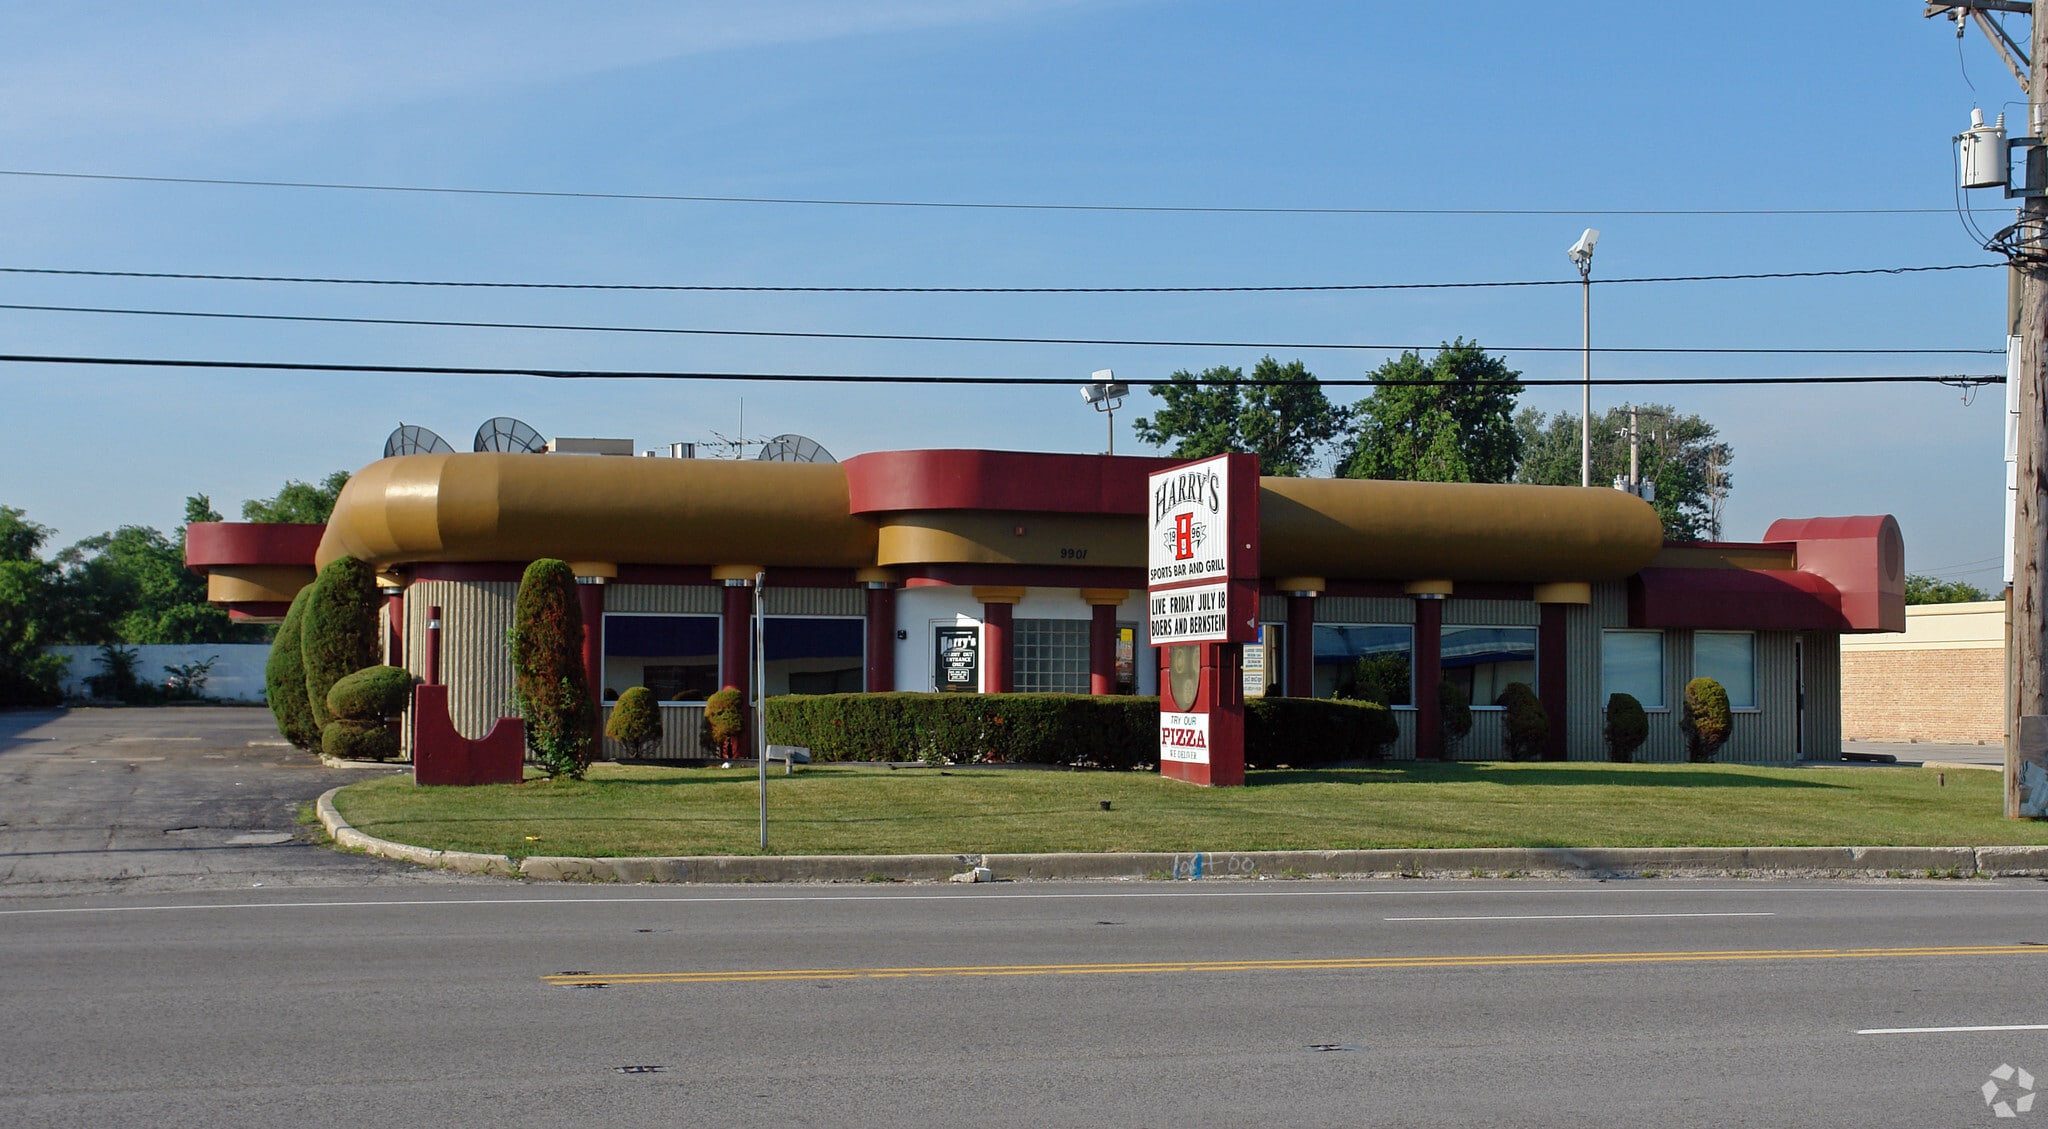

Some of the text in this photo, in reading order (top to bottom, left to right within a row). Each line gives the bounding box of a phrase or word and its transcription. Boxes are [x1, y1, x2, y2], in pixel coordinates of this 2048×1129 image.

[1155, 467, 1219, 530] HARRY'S
[1169, 512, 1201, 560] 19 H 96
[1060, 548, 1088, 560] 9901
[1150, 558, 1226, 581] SPORTS BAR AND GRILL
[1152, 591, 1226, 615] LIVE FRIDAY JULY 18
[1152, 614, 1226, 636] BOERS AND BERNSTEIN
[1171, 715, 1197, 726] TRY OUR
[1161, 727, 1207, 748] PIZZA
[1170, 750, 1198, 760] WE DELIVER
